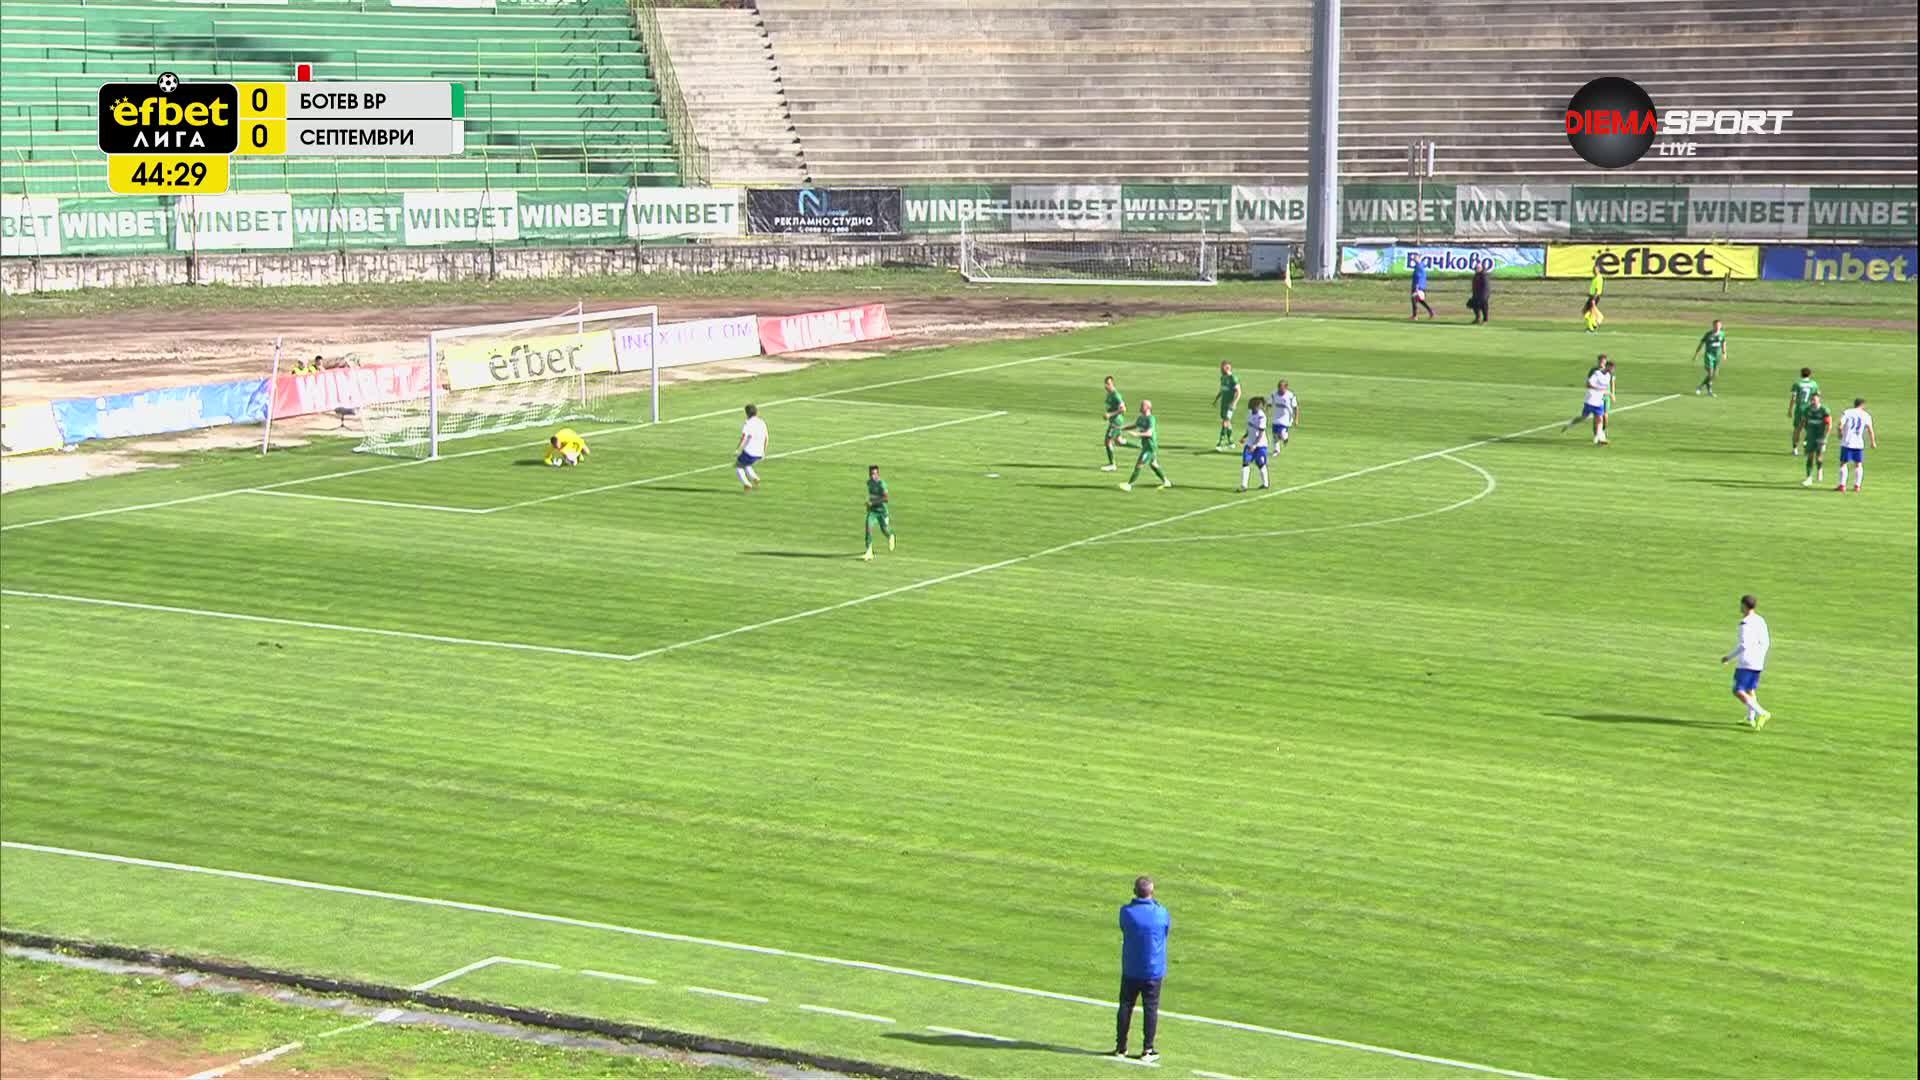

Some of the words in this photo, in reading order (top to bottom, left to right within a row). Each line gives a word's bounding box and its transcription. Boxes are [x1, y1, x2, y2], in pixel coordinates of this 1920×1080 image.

[180, 209, 288, 233] WINBET
[294, 205, 401, 233] WINBET
[408, 206, 513, 229] WINBET
[519, 203, 625, 228] WINBET
[632, 203, 735, 225] WINBET
[774, 216, 830, 226] РЕКЛАМНО
[832, 216, 874, 226] СТУДИО
[1123, 198, 1228, 222] WINBET
[1350, 199, 1452, 222] WINBET
[1460, 200, 1567, 222] WINBET
[1575, 200, 1686, 223] WINBET
[1694, 201, 1805, 223] WINBET
[60, 208, 173, 240] WINBET
[1595, 248, 1713, 275] efbet
